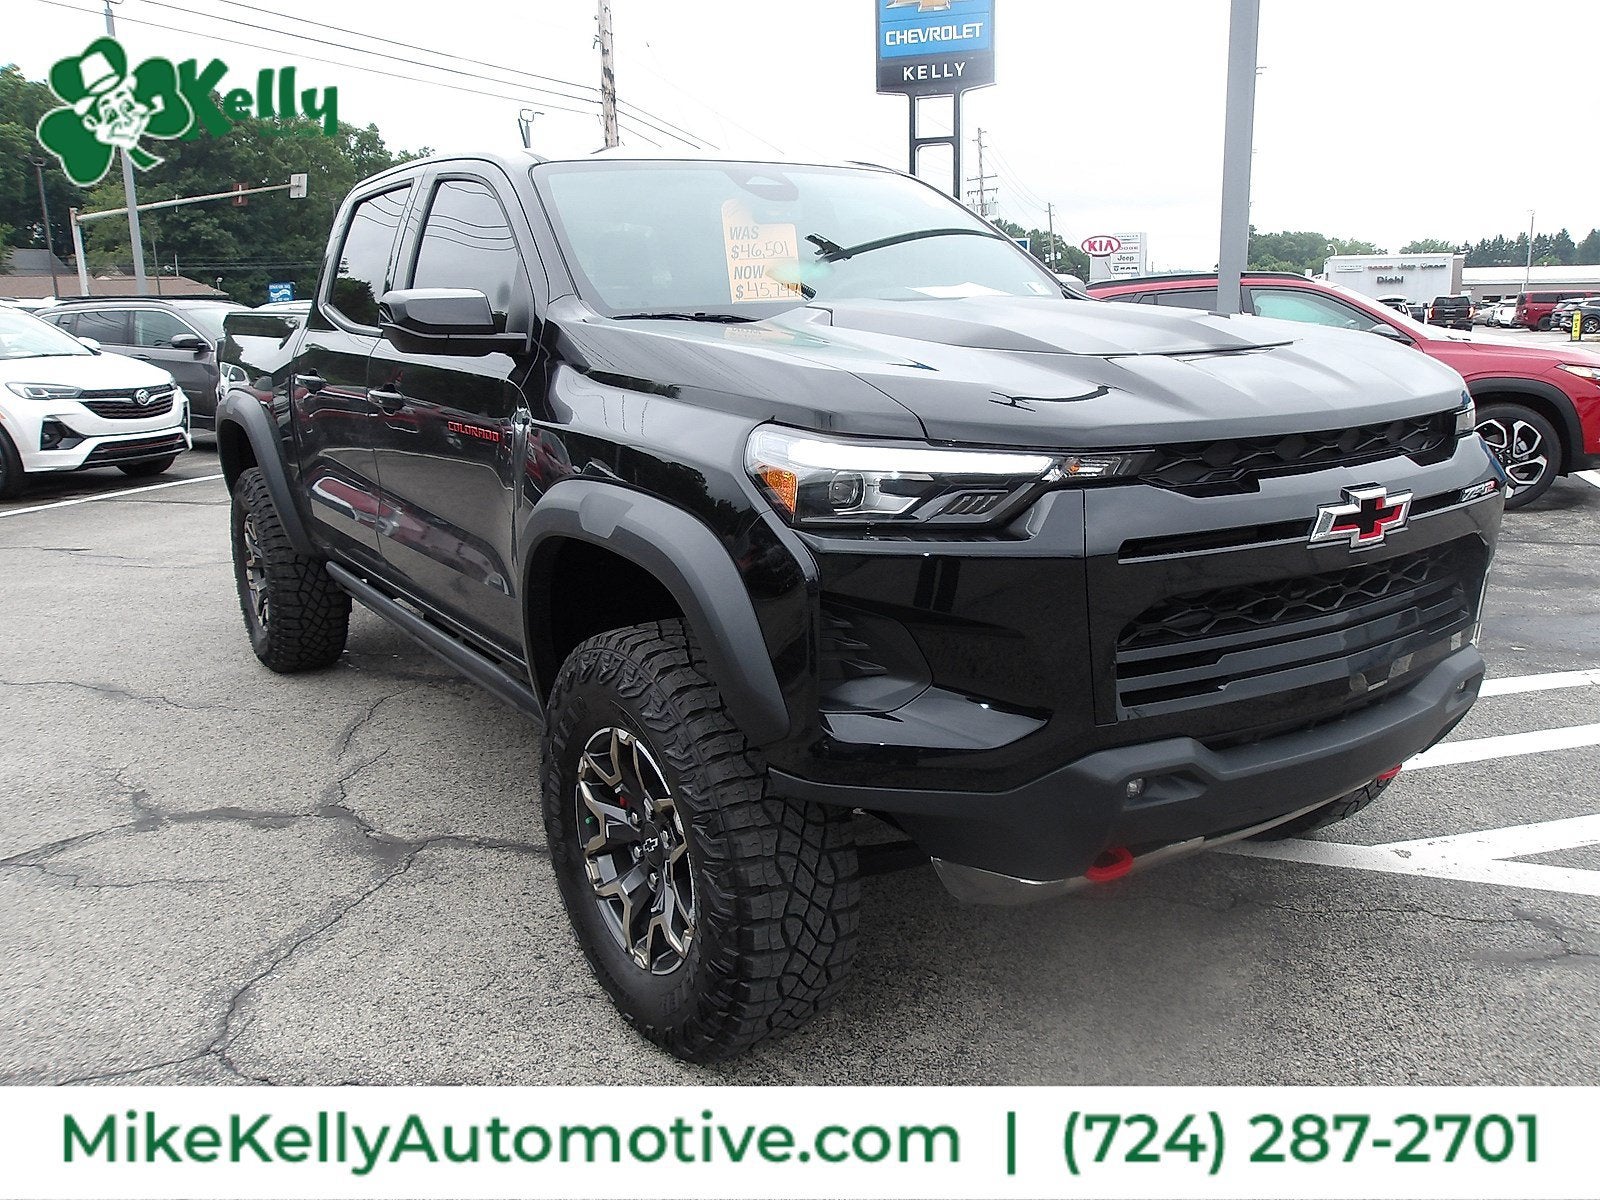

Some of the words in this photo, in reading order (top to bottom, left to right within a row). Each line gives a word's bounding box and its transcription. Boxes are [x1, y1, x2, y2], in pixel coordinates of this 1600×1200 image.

[885, 22, 984, 46] CHEVROLET
[903, 61, 966, 81] KELLY
[730, 226, 759, 240] WAS
[1087, 240, 1114, 252] KIA
[734, 265, 765, 280] NOW
[1376, 275, 1404, 284] Diehl
[447, 421, 500, 442] COLORADO
